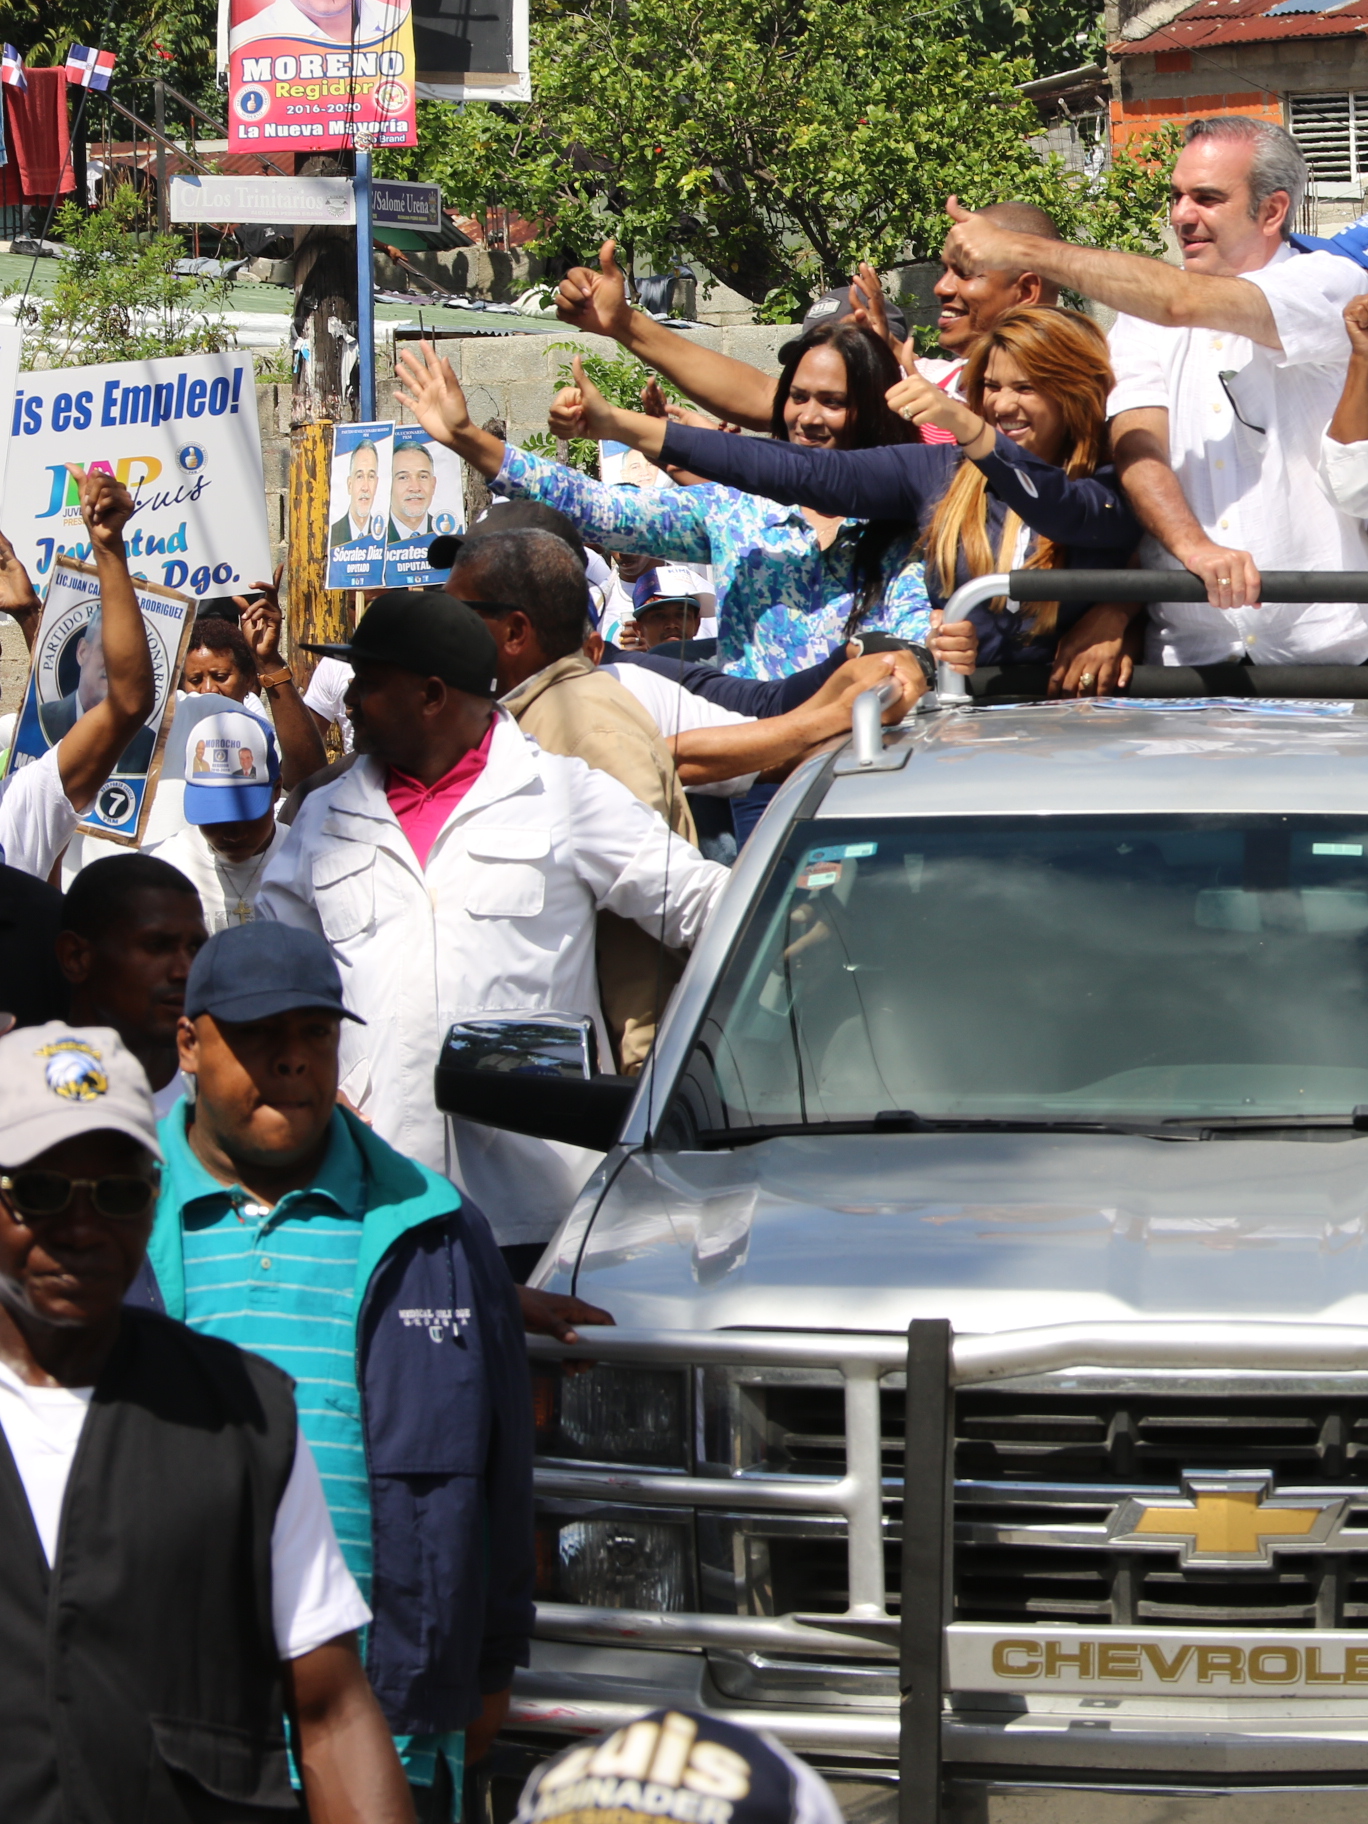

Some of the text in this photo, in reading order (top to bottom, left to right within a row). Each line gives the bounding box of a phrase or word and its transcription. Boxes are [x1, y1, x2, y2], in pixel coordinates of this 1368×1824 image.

[241, 51, 404, 82] MORENO
[275, 79, 374, 100] Regidor
[286, 103, 361, 115] 2016-2020
[238, 124, 260, 139] La
[264, 123, 324, 137] Nueva
[380, 134, 406, 143] Brand
[235, 187, 324, 209] Trinitarios
[372, 191, 405, 212] /Salomé
[51, 390, 93, 432] es
[100, 367, 244, 427] Empleo!
[333, 545, 383, 562] Sócrates Díaz
[161, 559, 240, 595] Dgo.
[347, 563, 370, 573] DIPUTADO
[140, 599, 184, 619] RODRIGUEZ
[43, 611, 84, 671] PARTIDO
[205, 739, 241, 749] MOROCHO
[110, 792, 126, 816] 7
[537, 1710, 751, 1800] Luis
